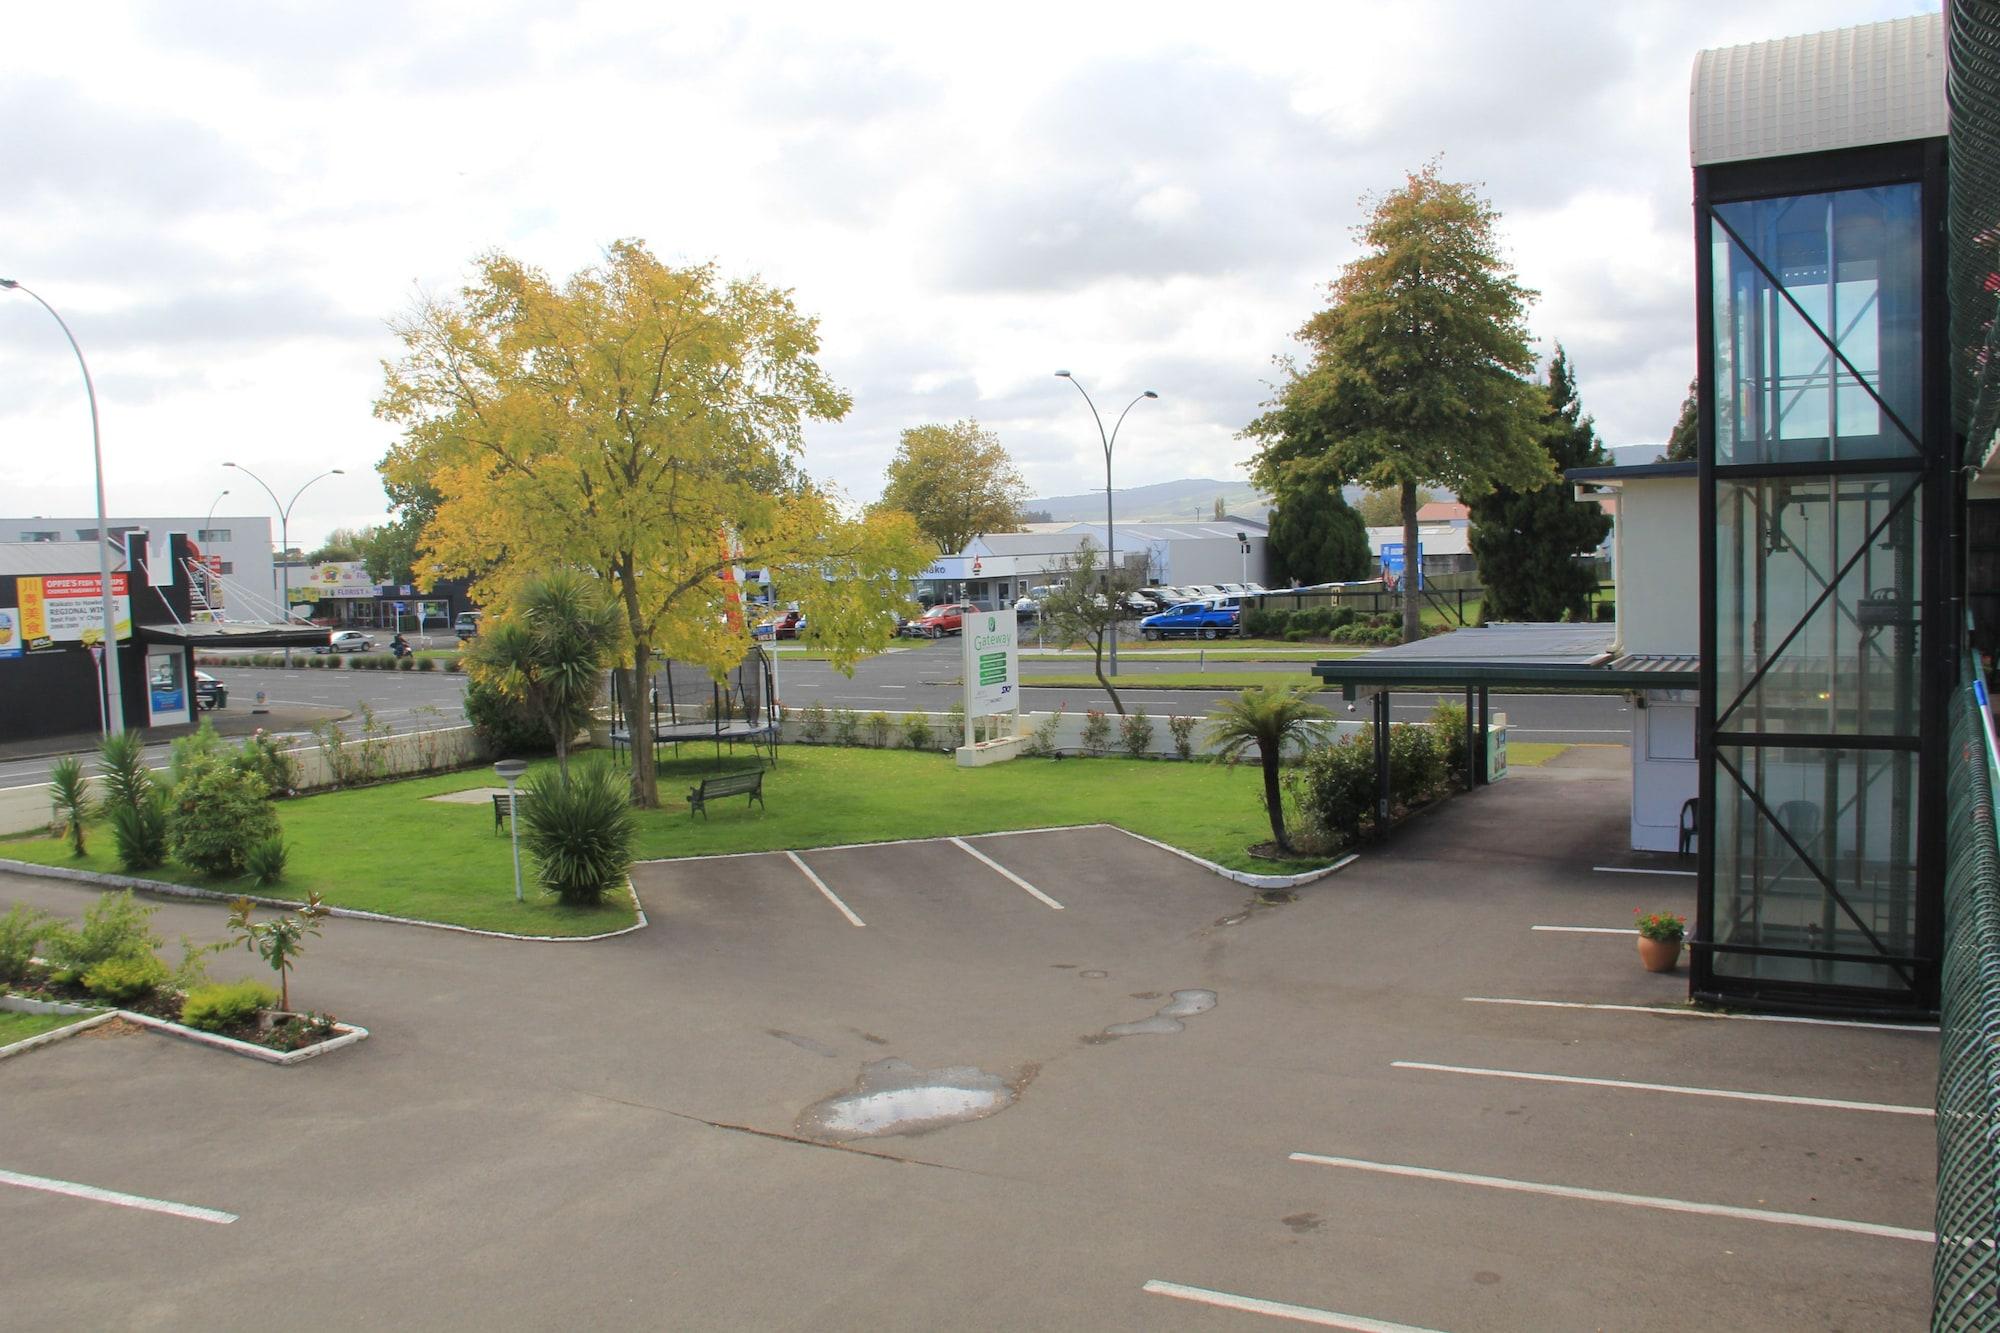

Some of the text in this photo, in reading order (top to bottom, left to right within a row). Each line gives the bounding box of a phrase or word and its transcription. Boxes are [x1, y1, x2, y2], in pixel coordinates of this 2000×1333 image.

[337, 588, 364, 596] FLORIST
[49, 607, 87, 615] REGIONAL
[975, 632, 1011, 651] Gateway
